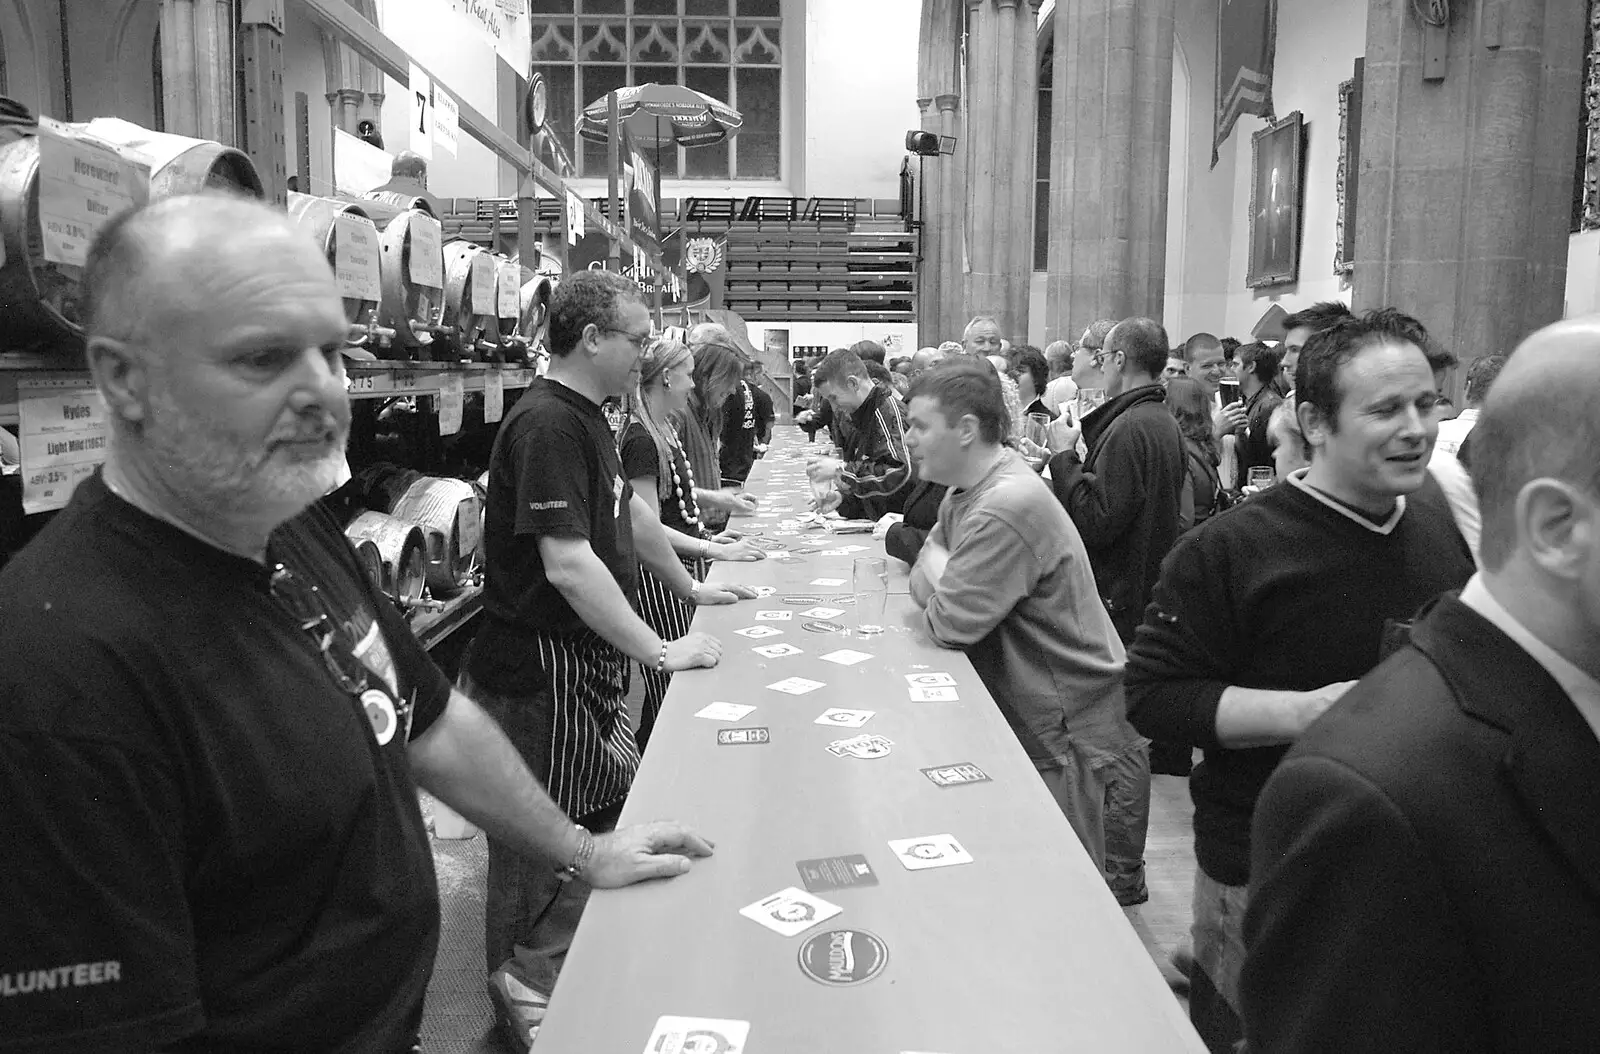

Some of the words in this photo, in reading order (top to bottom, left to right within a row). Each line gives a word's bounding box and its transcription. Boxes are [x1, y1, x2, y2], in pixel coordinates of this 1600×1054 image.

[415, 91, 426, 134] 7
[74, 156, 119, 185] Hereward
[63, 404, 91, 420] Hydes
[47, 441, 68, 455] Light
[529, 500, 568, 510] VOLUNTEER
